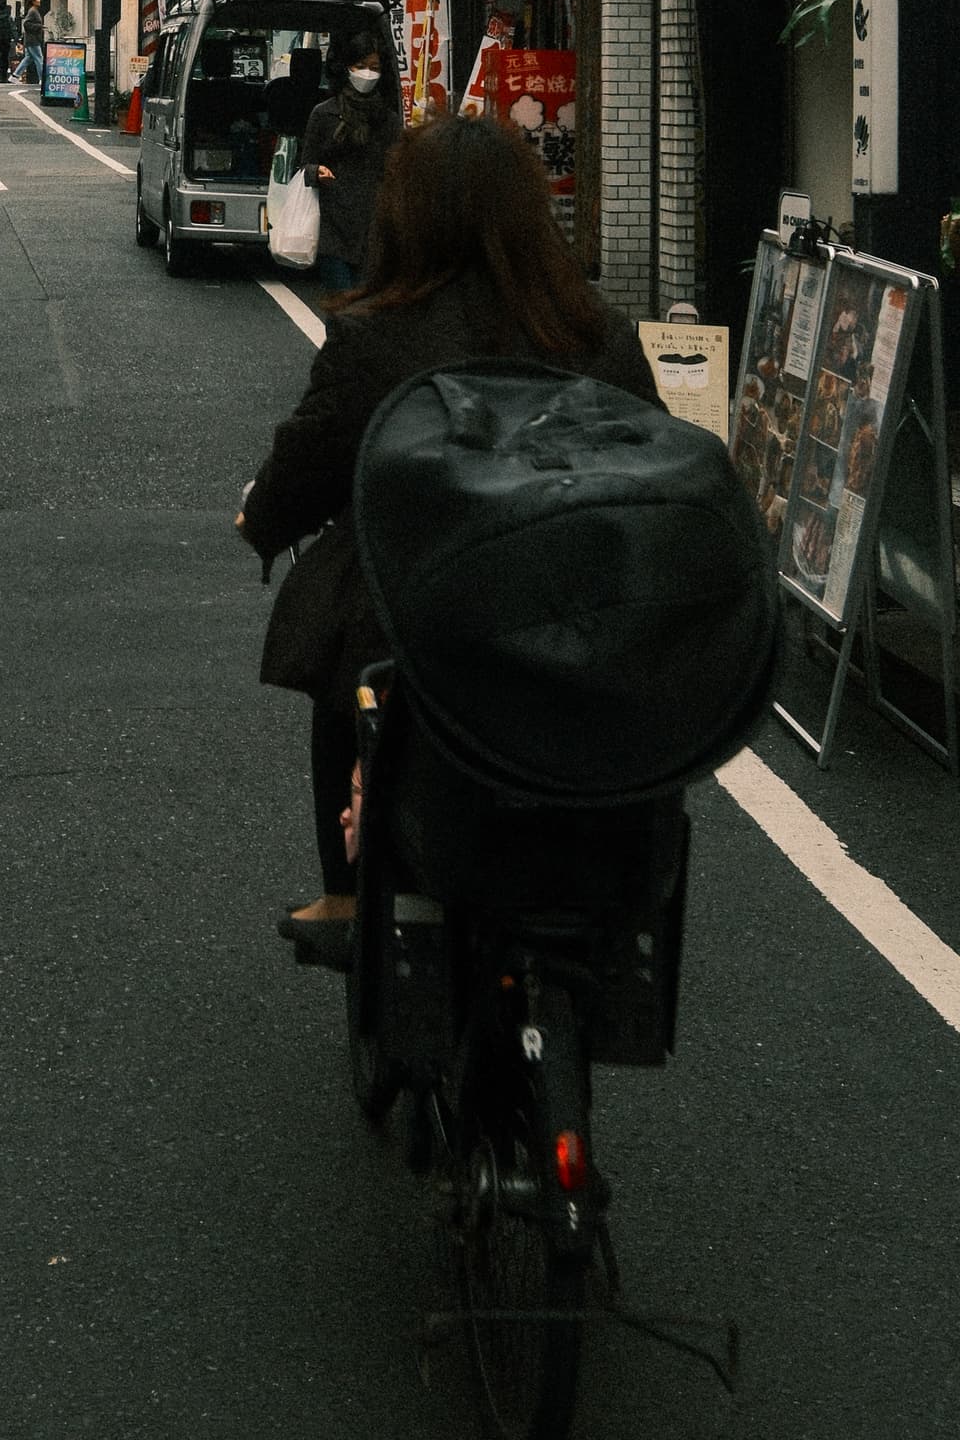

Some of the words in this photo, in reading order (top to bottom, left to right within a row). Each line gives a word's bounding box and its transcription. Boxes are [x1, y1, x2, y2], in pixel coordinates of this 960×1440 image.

[506, 52, 538, 69] 元氣
[49, 75, 80, 84] 1,000円
[48, 84, 65, 92] OFF
